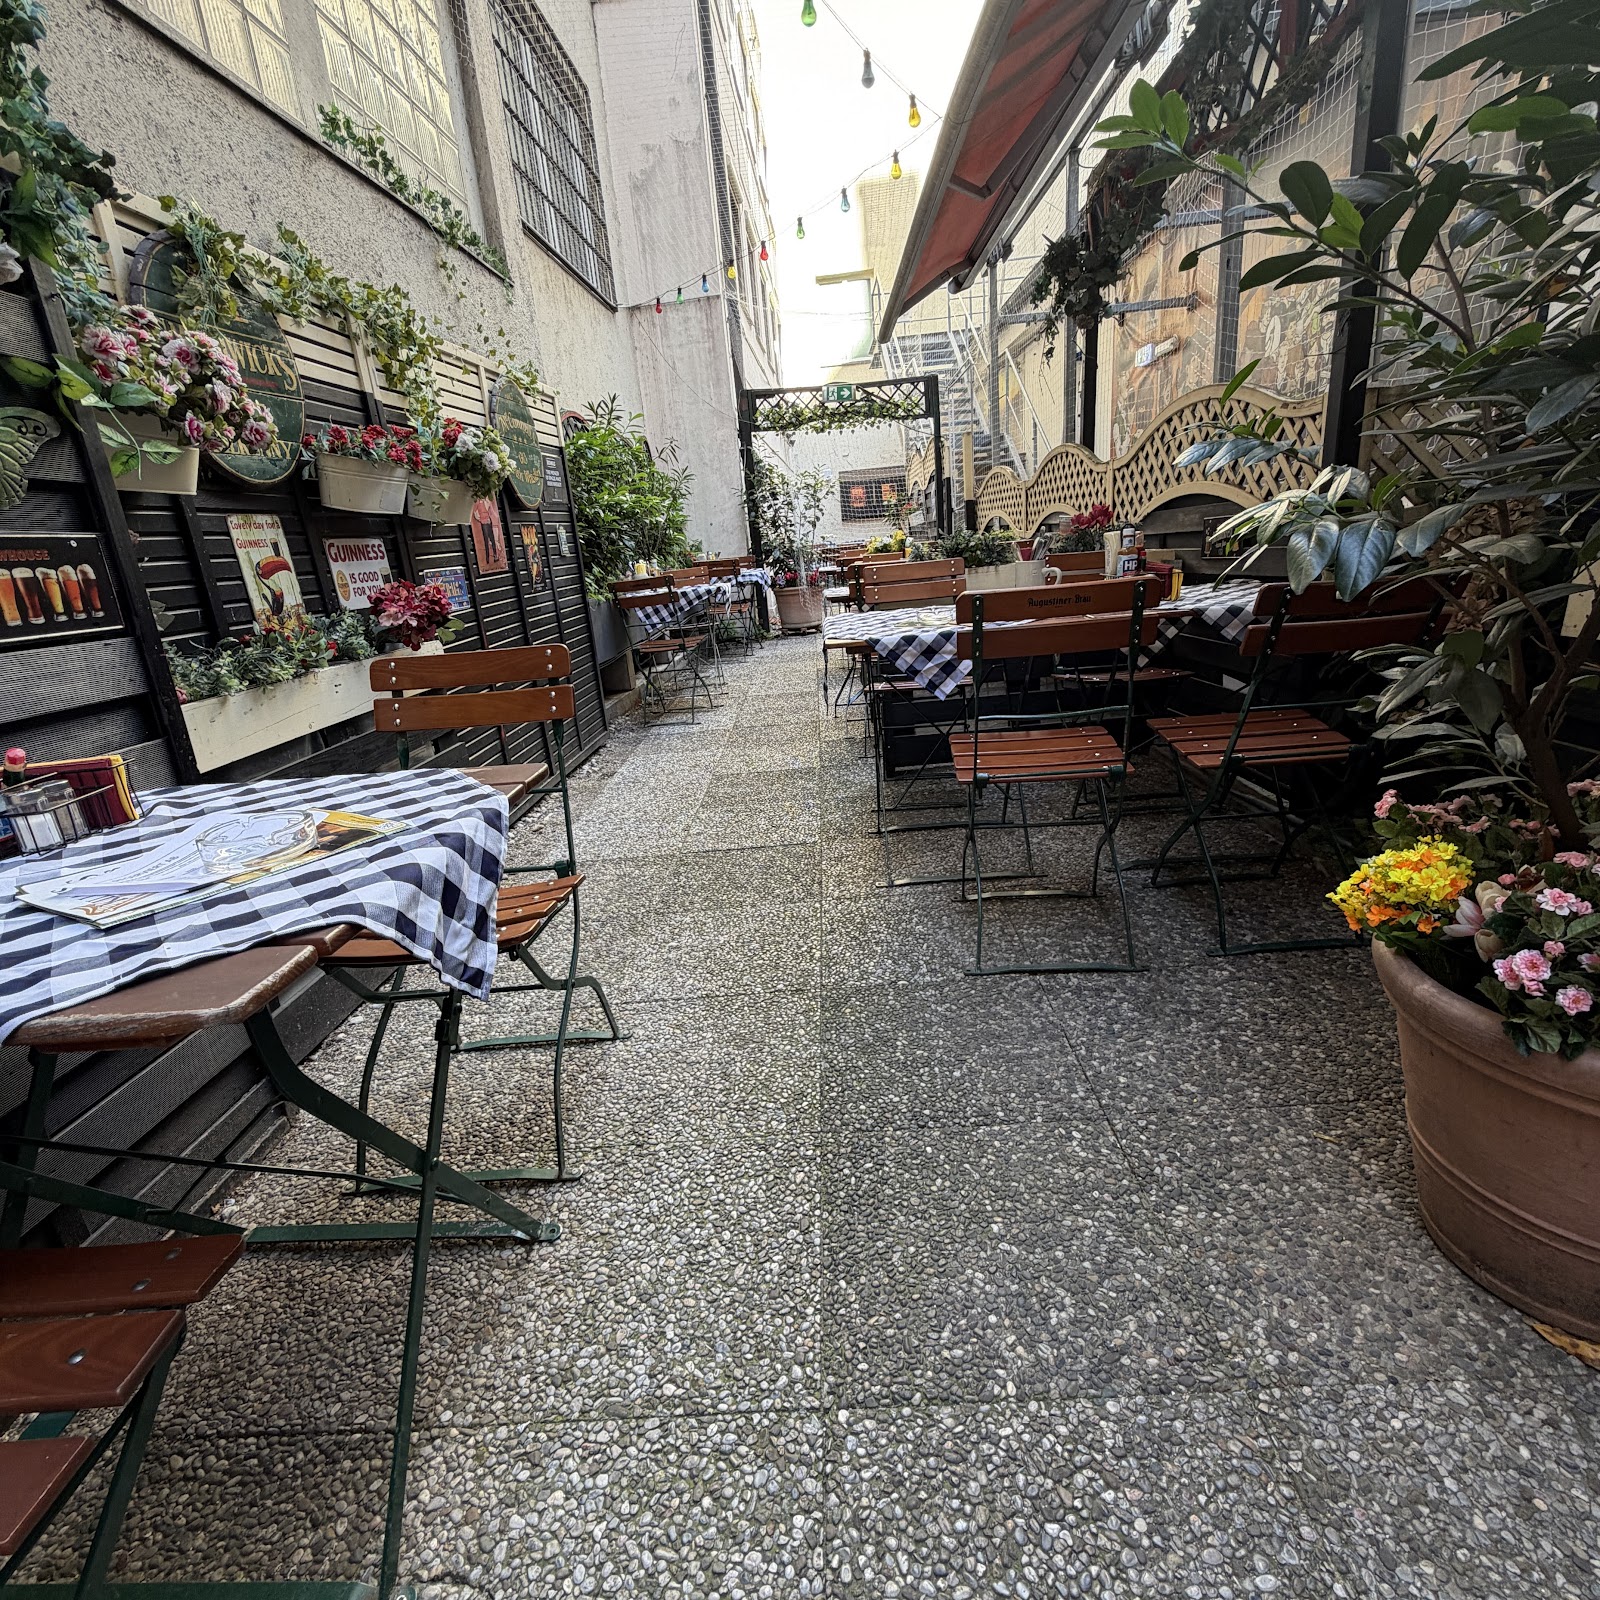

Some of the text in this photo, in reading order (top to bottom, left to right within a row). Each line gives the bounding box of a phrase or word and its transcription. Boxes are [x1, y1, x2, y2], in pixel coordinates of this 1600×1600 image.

[230, 520, 252, 531] Lovely
[253, 520, 264, 530] day
[236, 538, 269, 549] GUINNESS
[327, 542, 386, 563] GUINNESS
[1124, 560, 1138, 571] HP
[349, 571, 380, 585] IS GOOD
[352, 586, 367, 598] FOR
[1028, 597, 1073, 609] Augustiner
